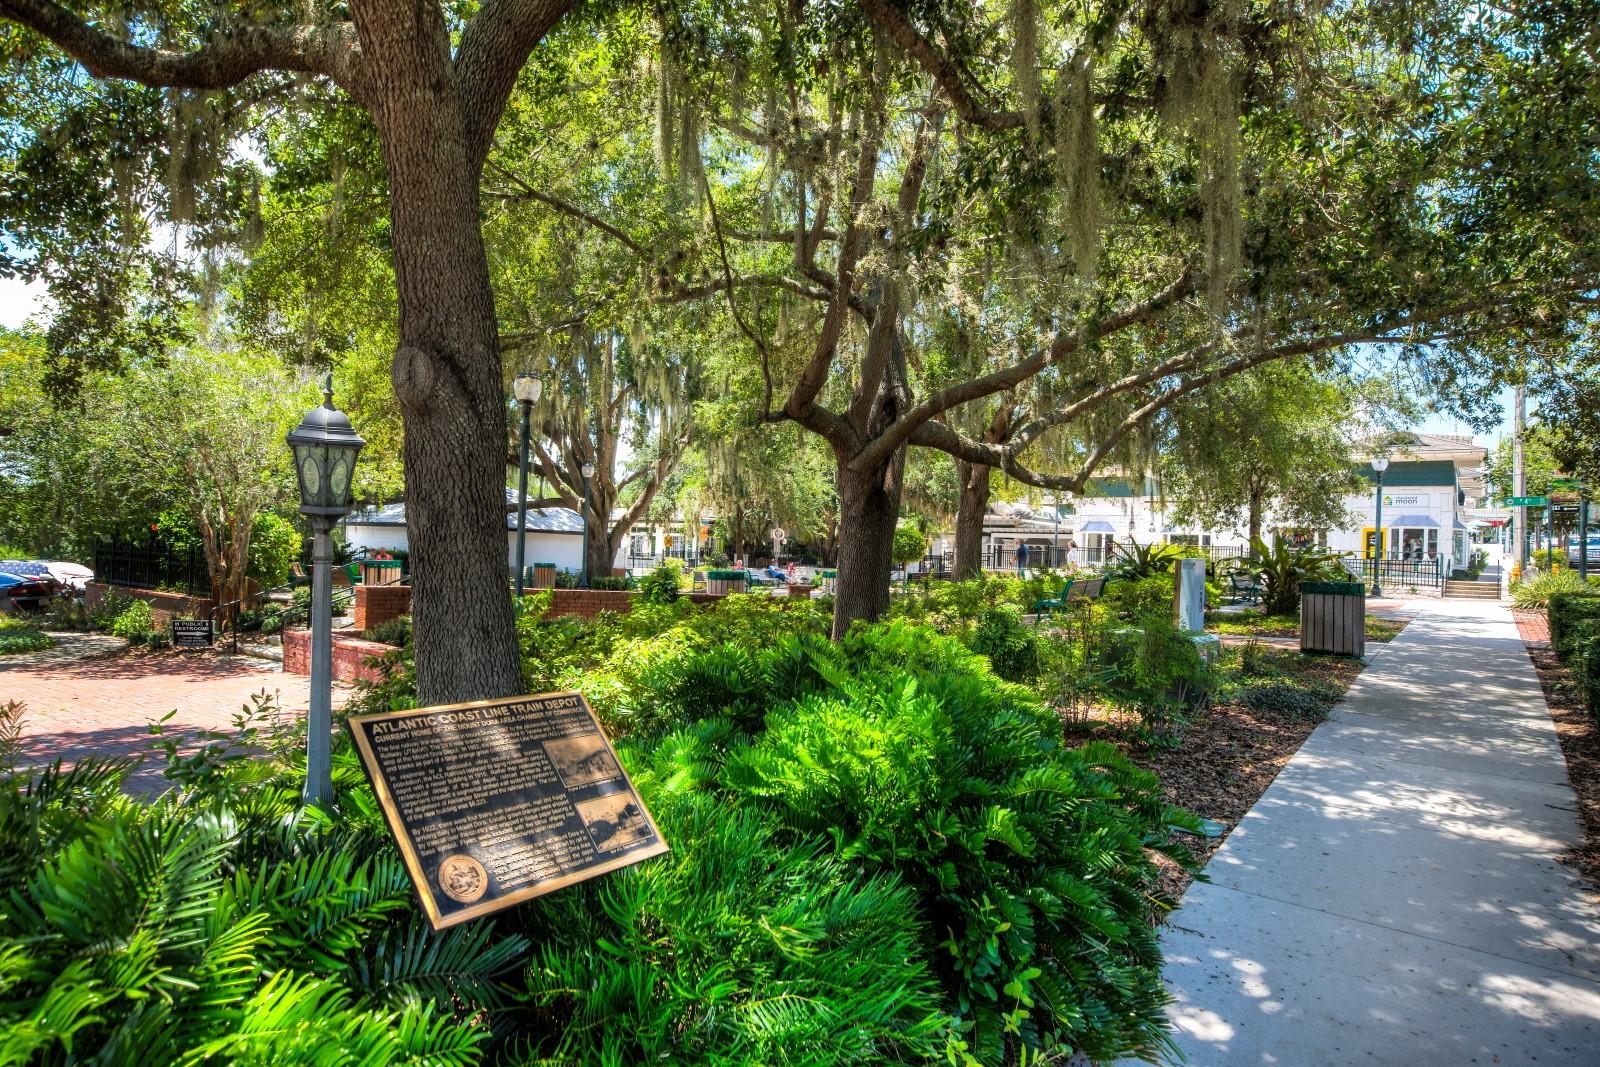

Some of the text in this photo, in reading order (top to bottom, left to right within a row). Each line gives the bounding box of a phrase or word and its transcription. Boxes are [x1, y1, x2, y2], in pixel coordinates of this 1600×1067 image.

[371, 697, 577, 734] ATLANTIC COAST LINE TRAIN DEPOT
[375, 732, 410, 742] CURRENT
[411, 729, 431, 737] HOME
[458, 722, 480, 730] MOUNT
[517, 712, 544, 721] CHAMBER
[553, 707, 582, 716] COMMERCE
